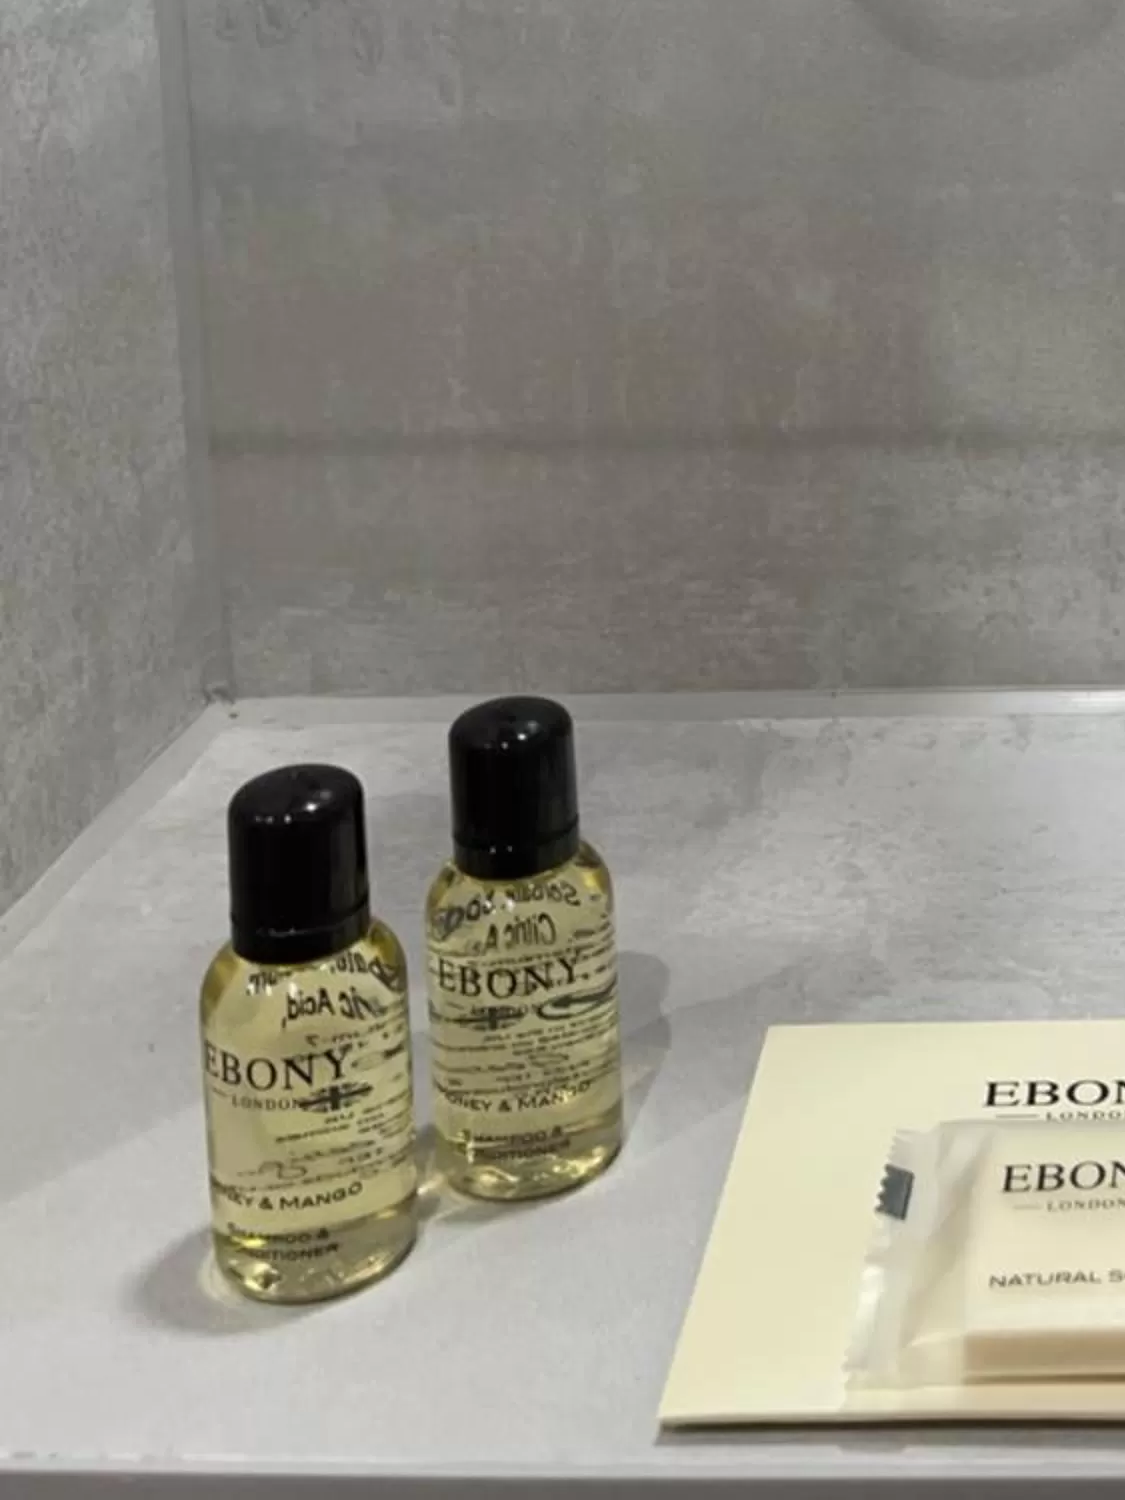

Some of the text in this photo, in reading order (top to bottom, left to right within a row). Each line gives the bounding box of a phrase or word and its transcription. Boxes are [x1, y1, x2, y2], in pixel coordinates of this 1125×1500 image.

[438, 954, 585, 999] EBONY
[204, 1042, 348, 1091] EBONY
[259, 1196, 274, 1211] &
[279, 1180, 363, 1211] MANGO
[989, 1272, 1102, 1289] NATURAL
